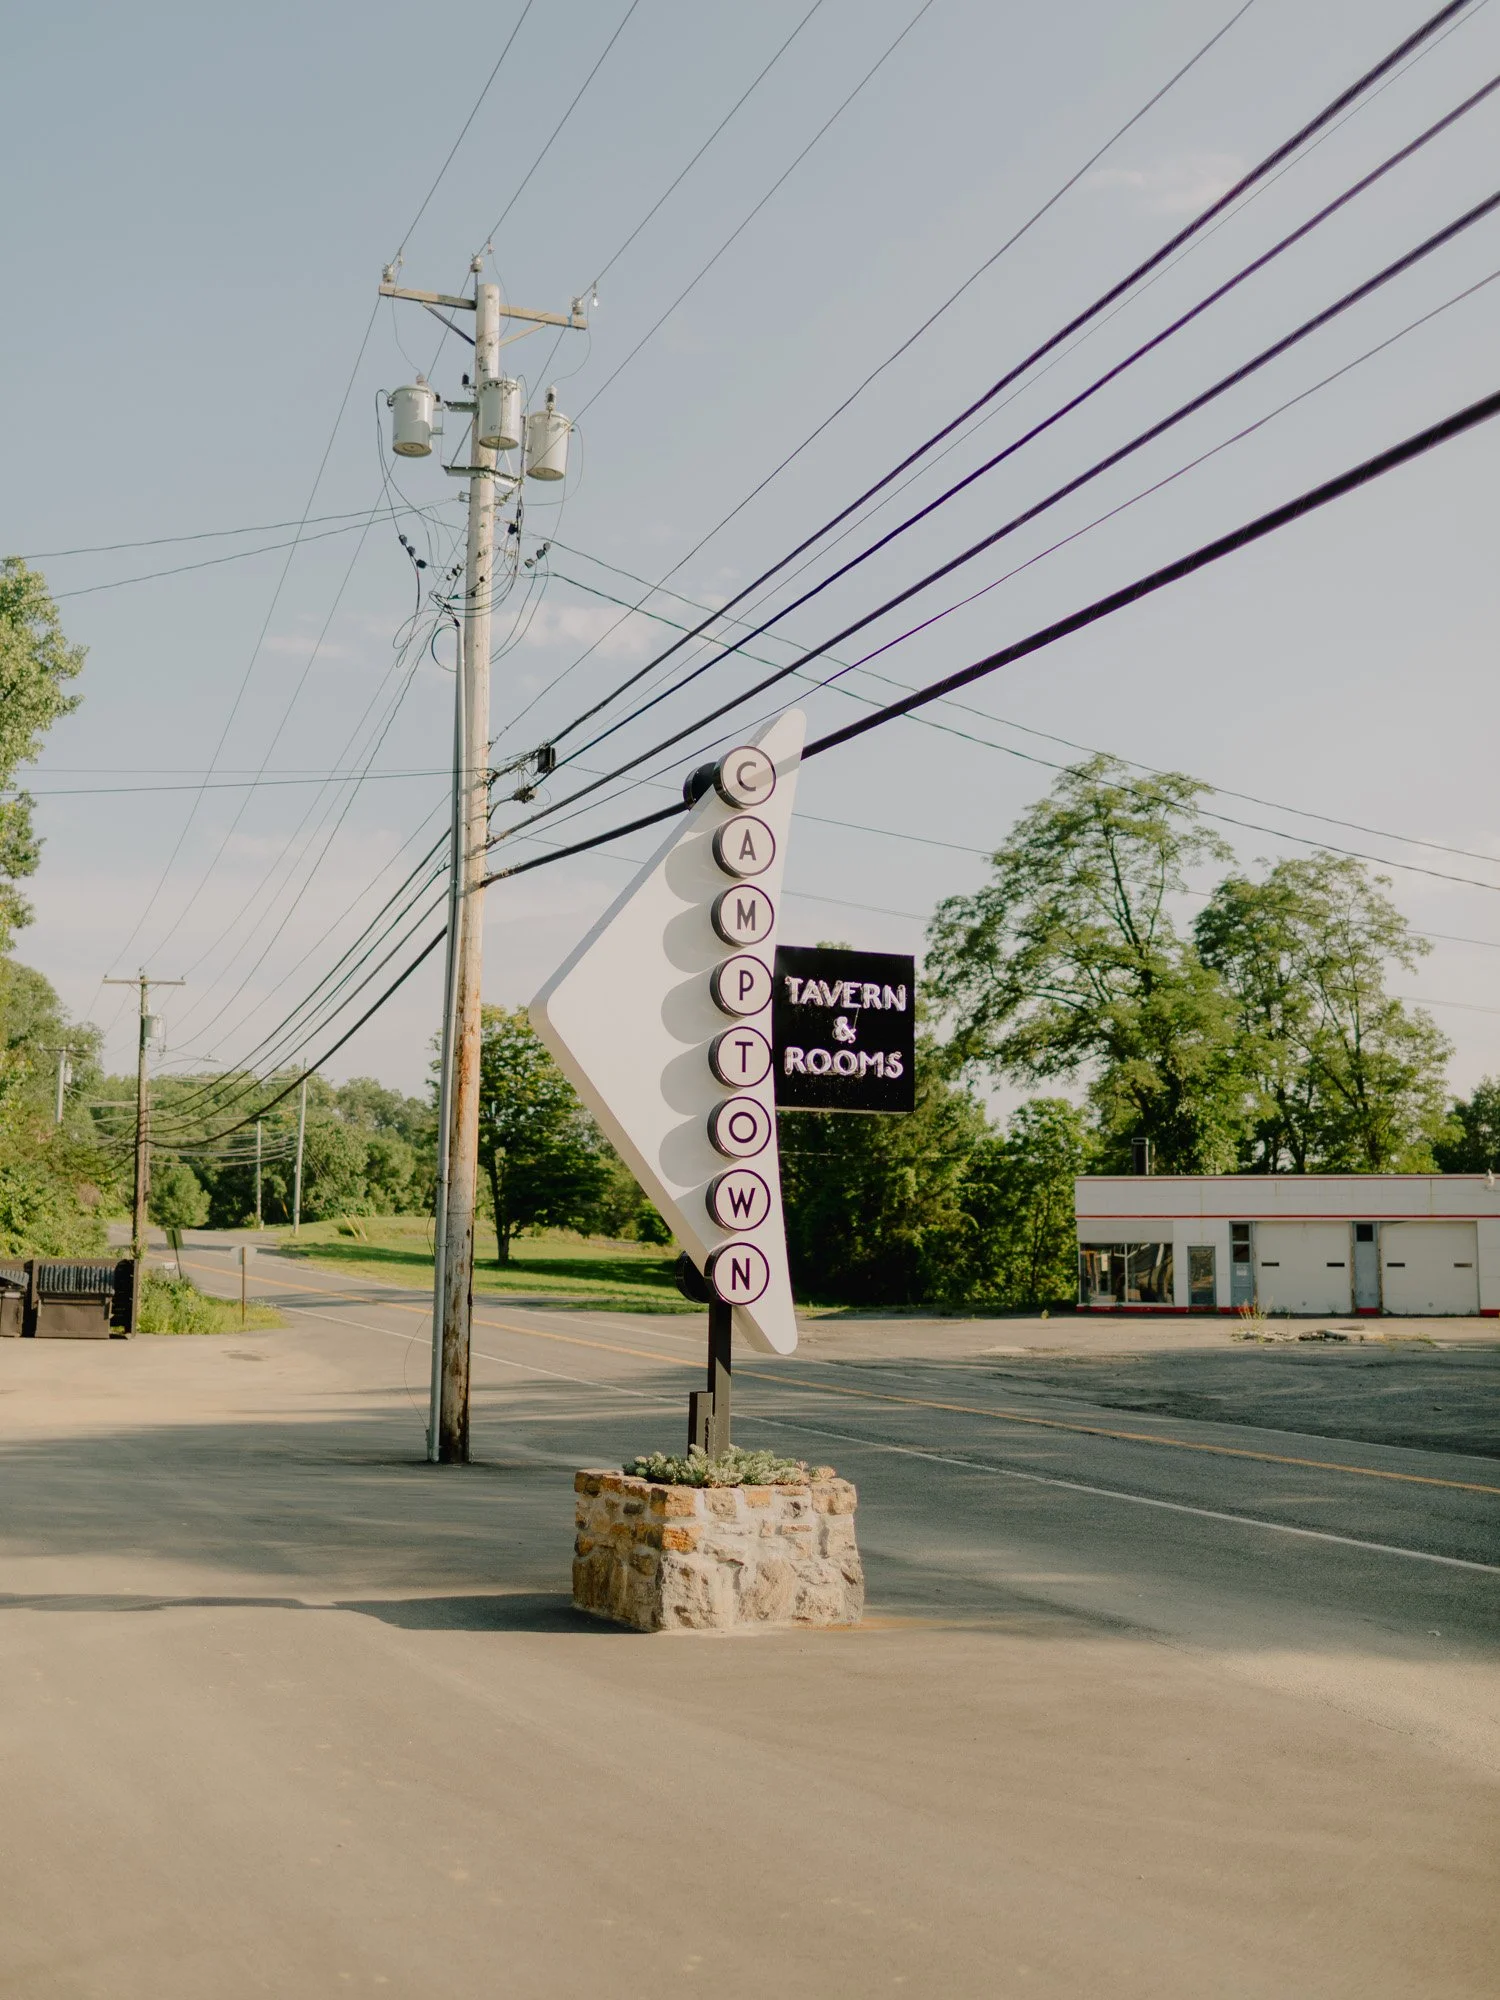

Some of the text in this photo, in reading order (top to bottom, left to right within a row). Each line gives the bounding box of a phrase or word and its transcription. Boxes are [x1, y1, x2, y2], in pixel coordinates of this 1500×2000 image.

[785, 976, 907, 1011] TAVERN
[832, 1016, 857, 1043] &
[785, 1046, 904, 1079] ROOMS
